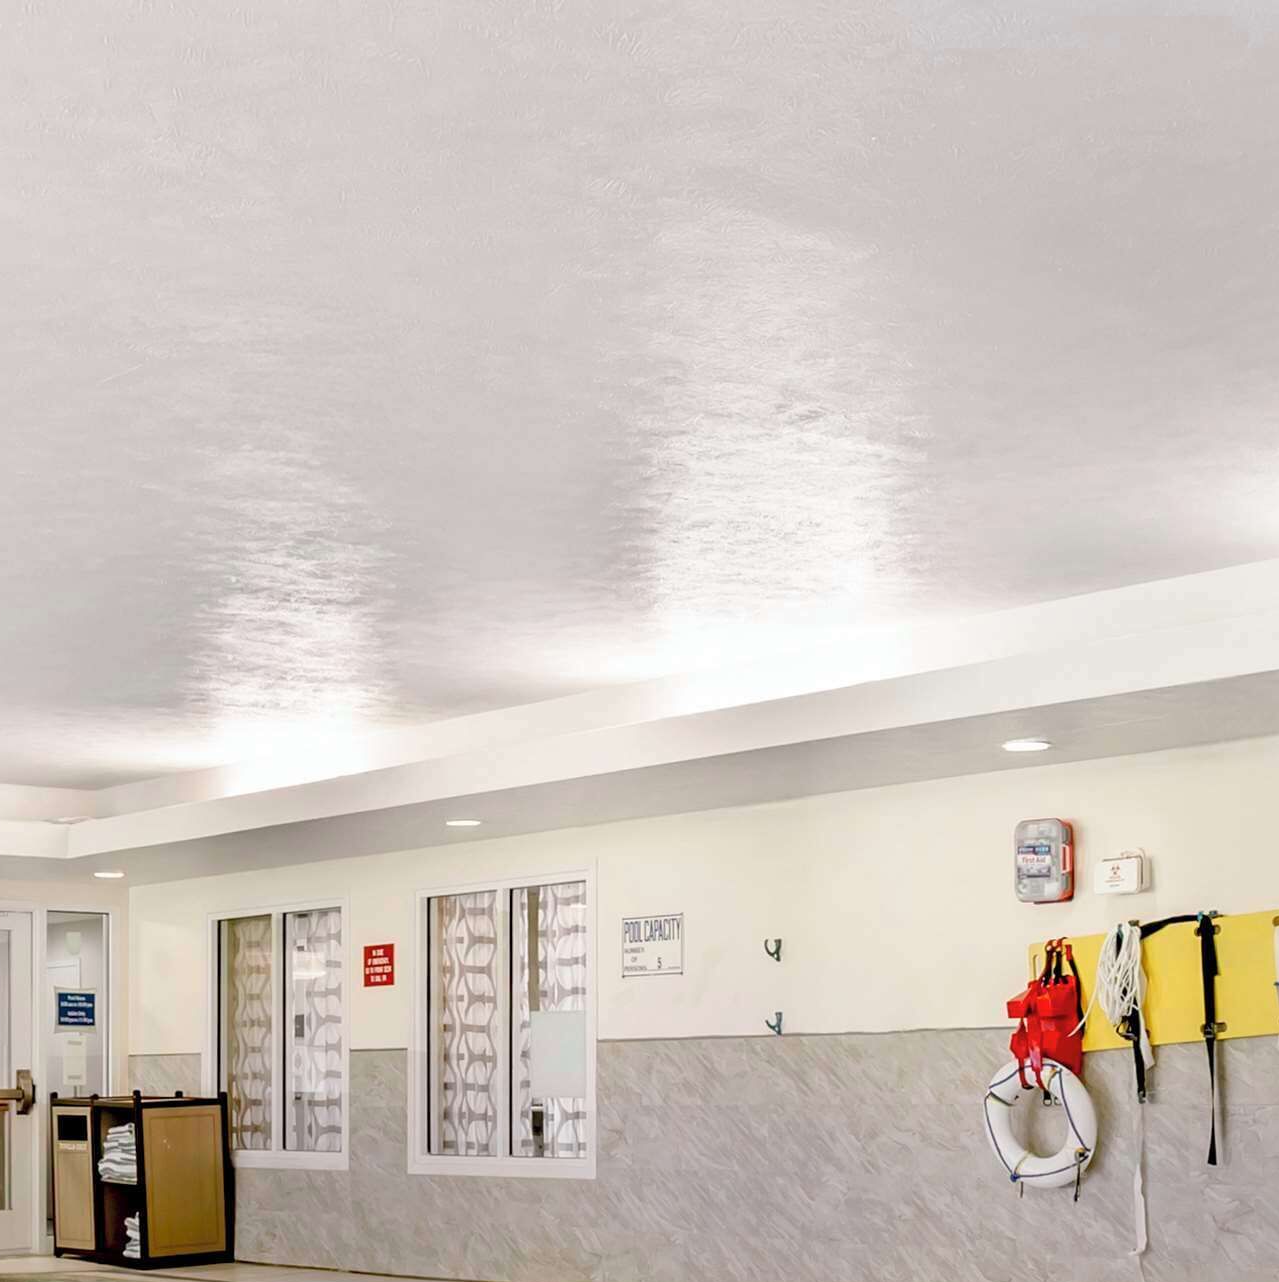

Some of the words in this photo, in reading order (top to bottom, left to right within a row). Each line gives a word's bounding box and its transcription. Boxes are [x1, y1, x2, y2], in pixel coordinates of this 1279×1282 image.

[624, 920, 643, 943] POOL
[644, 917, 680, 942] CAPACITY
[657, 956, 663, 969] 5
